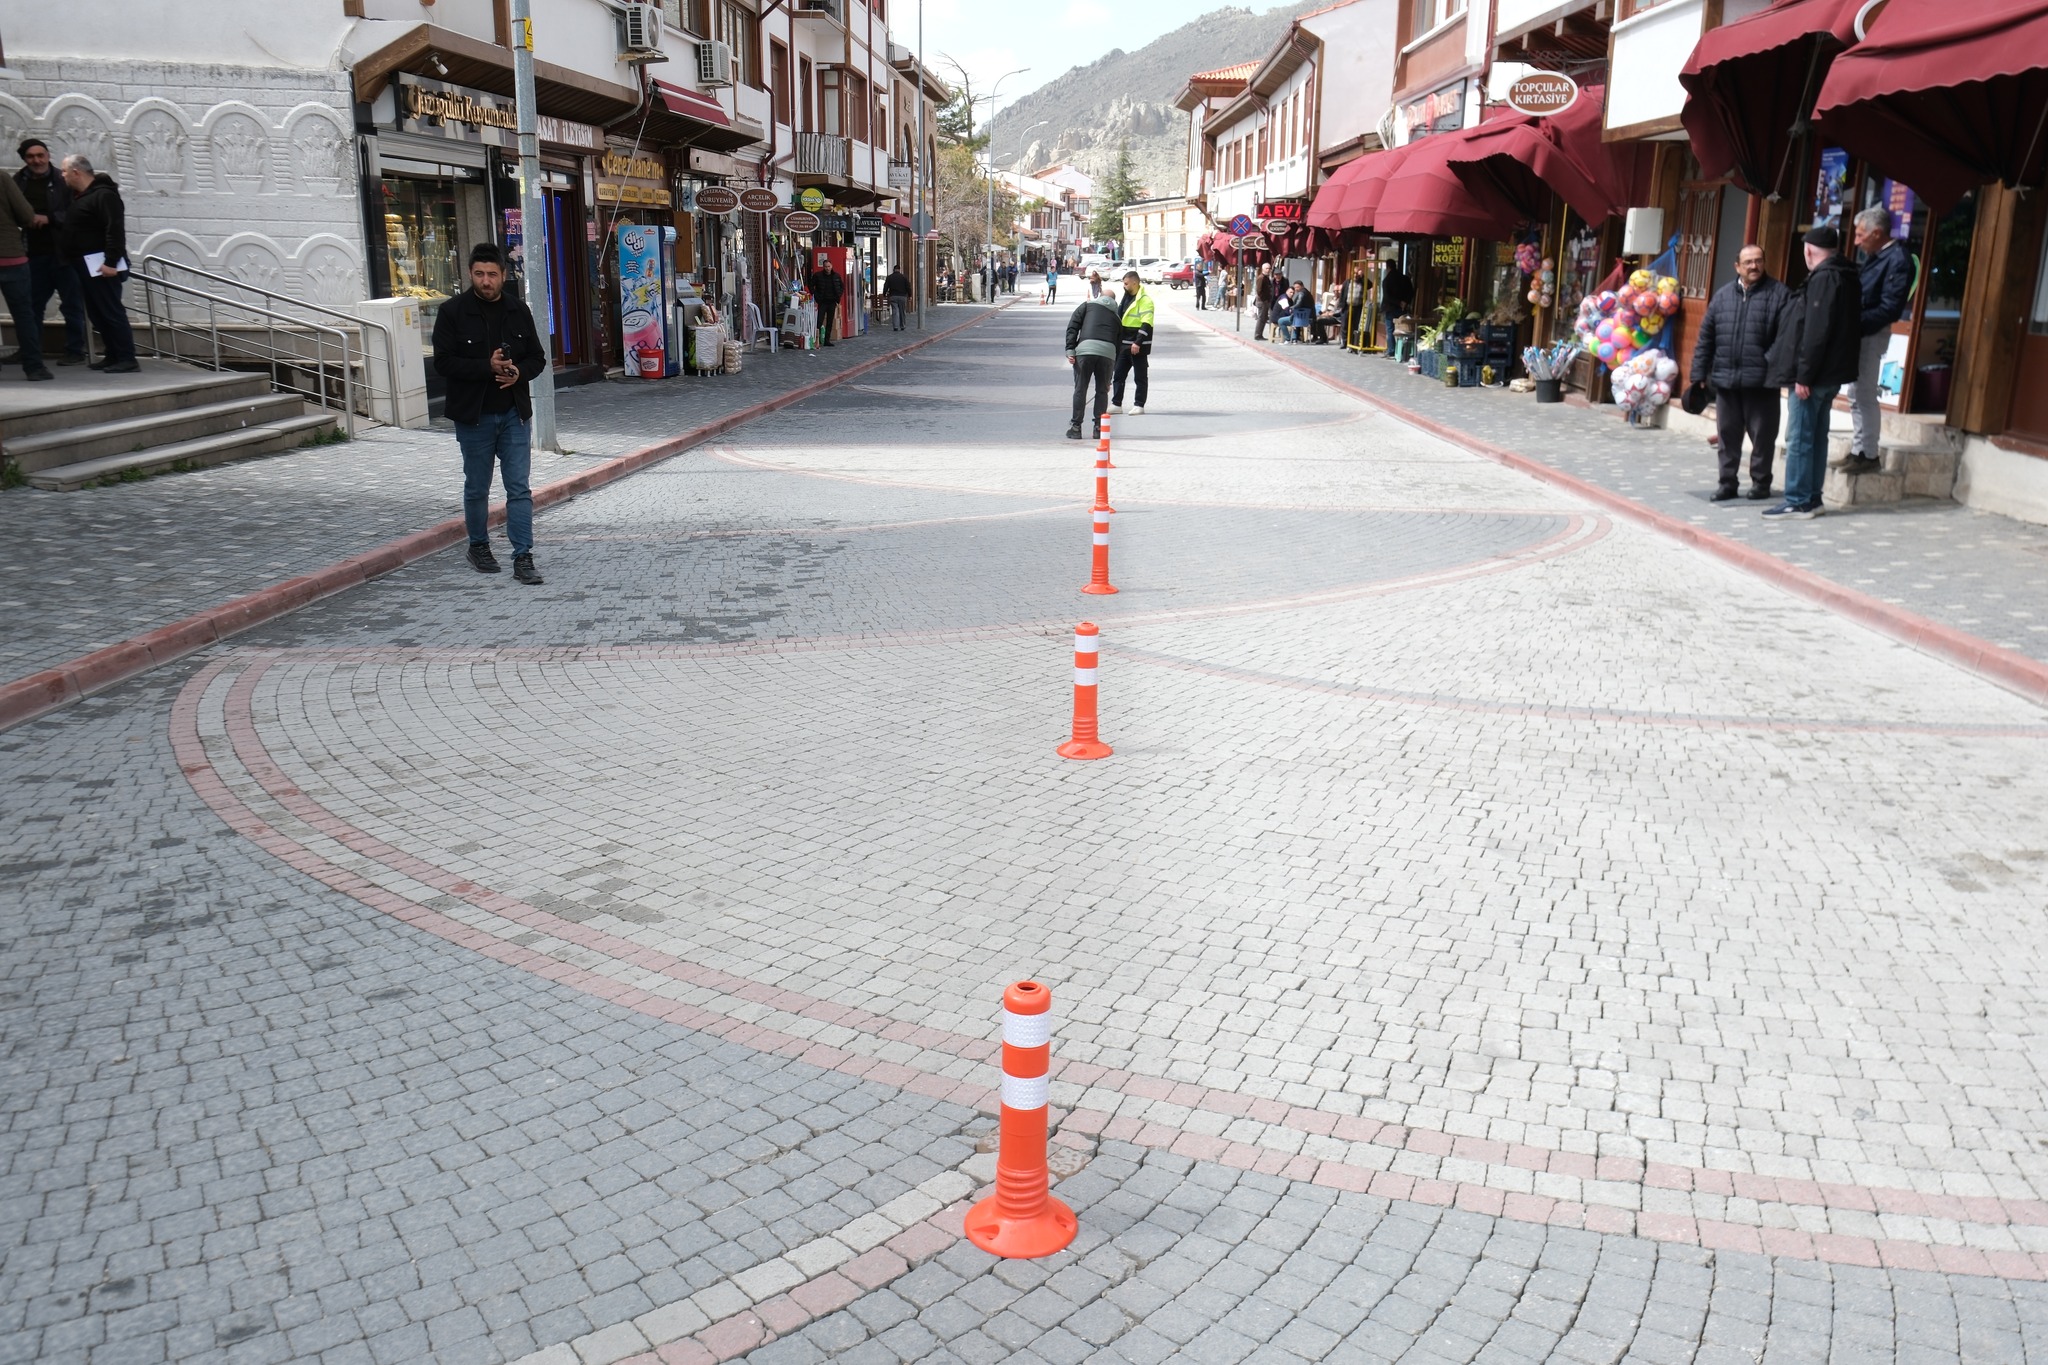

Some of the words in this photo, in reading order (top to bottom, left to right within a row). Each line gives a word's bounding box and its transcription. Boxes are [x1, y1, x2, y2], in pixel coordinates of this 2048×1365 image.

[1514, 82, 1570, 94] TOPÇULAR
[1515, 93, 1568, 104] KIRTASİYE
[562, 121, 594, 148] İLETİŞİM
[699, 196, 734, 205] KURUYEMİŞ
[625, 231, 637, 246] di
[633, 236, 645, 251] di
